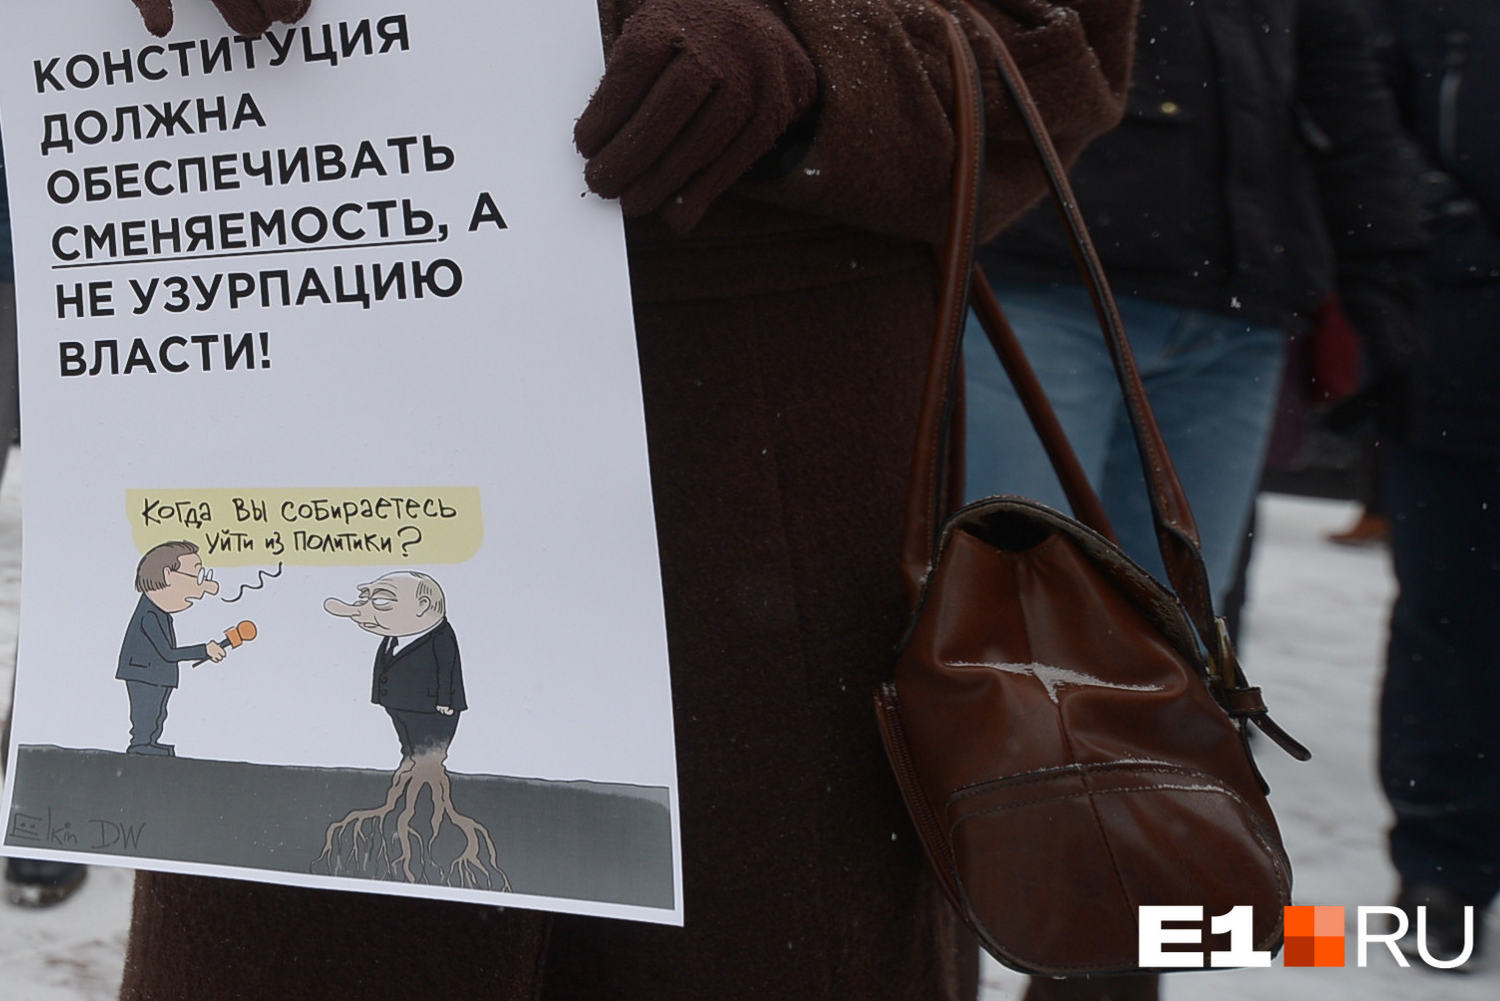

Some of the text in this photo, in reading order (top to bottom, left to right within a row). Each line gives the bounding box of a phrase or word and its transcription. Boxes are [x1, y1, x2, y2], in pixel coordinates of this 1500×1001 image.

[33, 14, 410, 94] КОНСТИТУЦИЯ
[40, 93, 267, 156] ДОЛЖНА
[47, 135, 455, 204] ОБЕСПЕЧИВАТЬ
[52, 192, 508, 261] СМЕНЯЕМОСТЬ, А
[56, 258, 463, 319] НЕ УЗУРПАЦИЮ
[59, 331, 270, 377] ВЛАСТИ!
[141, 498, 212, 529] Когда
[265, 531, 285, 556] из
[88, 819, 147, 849] DW
